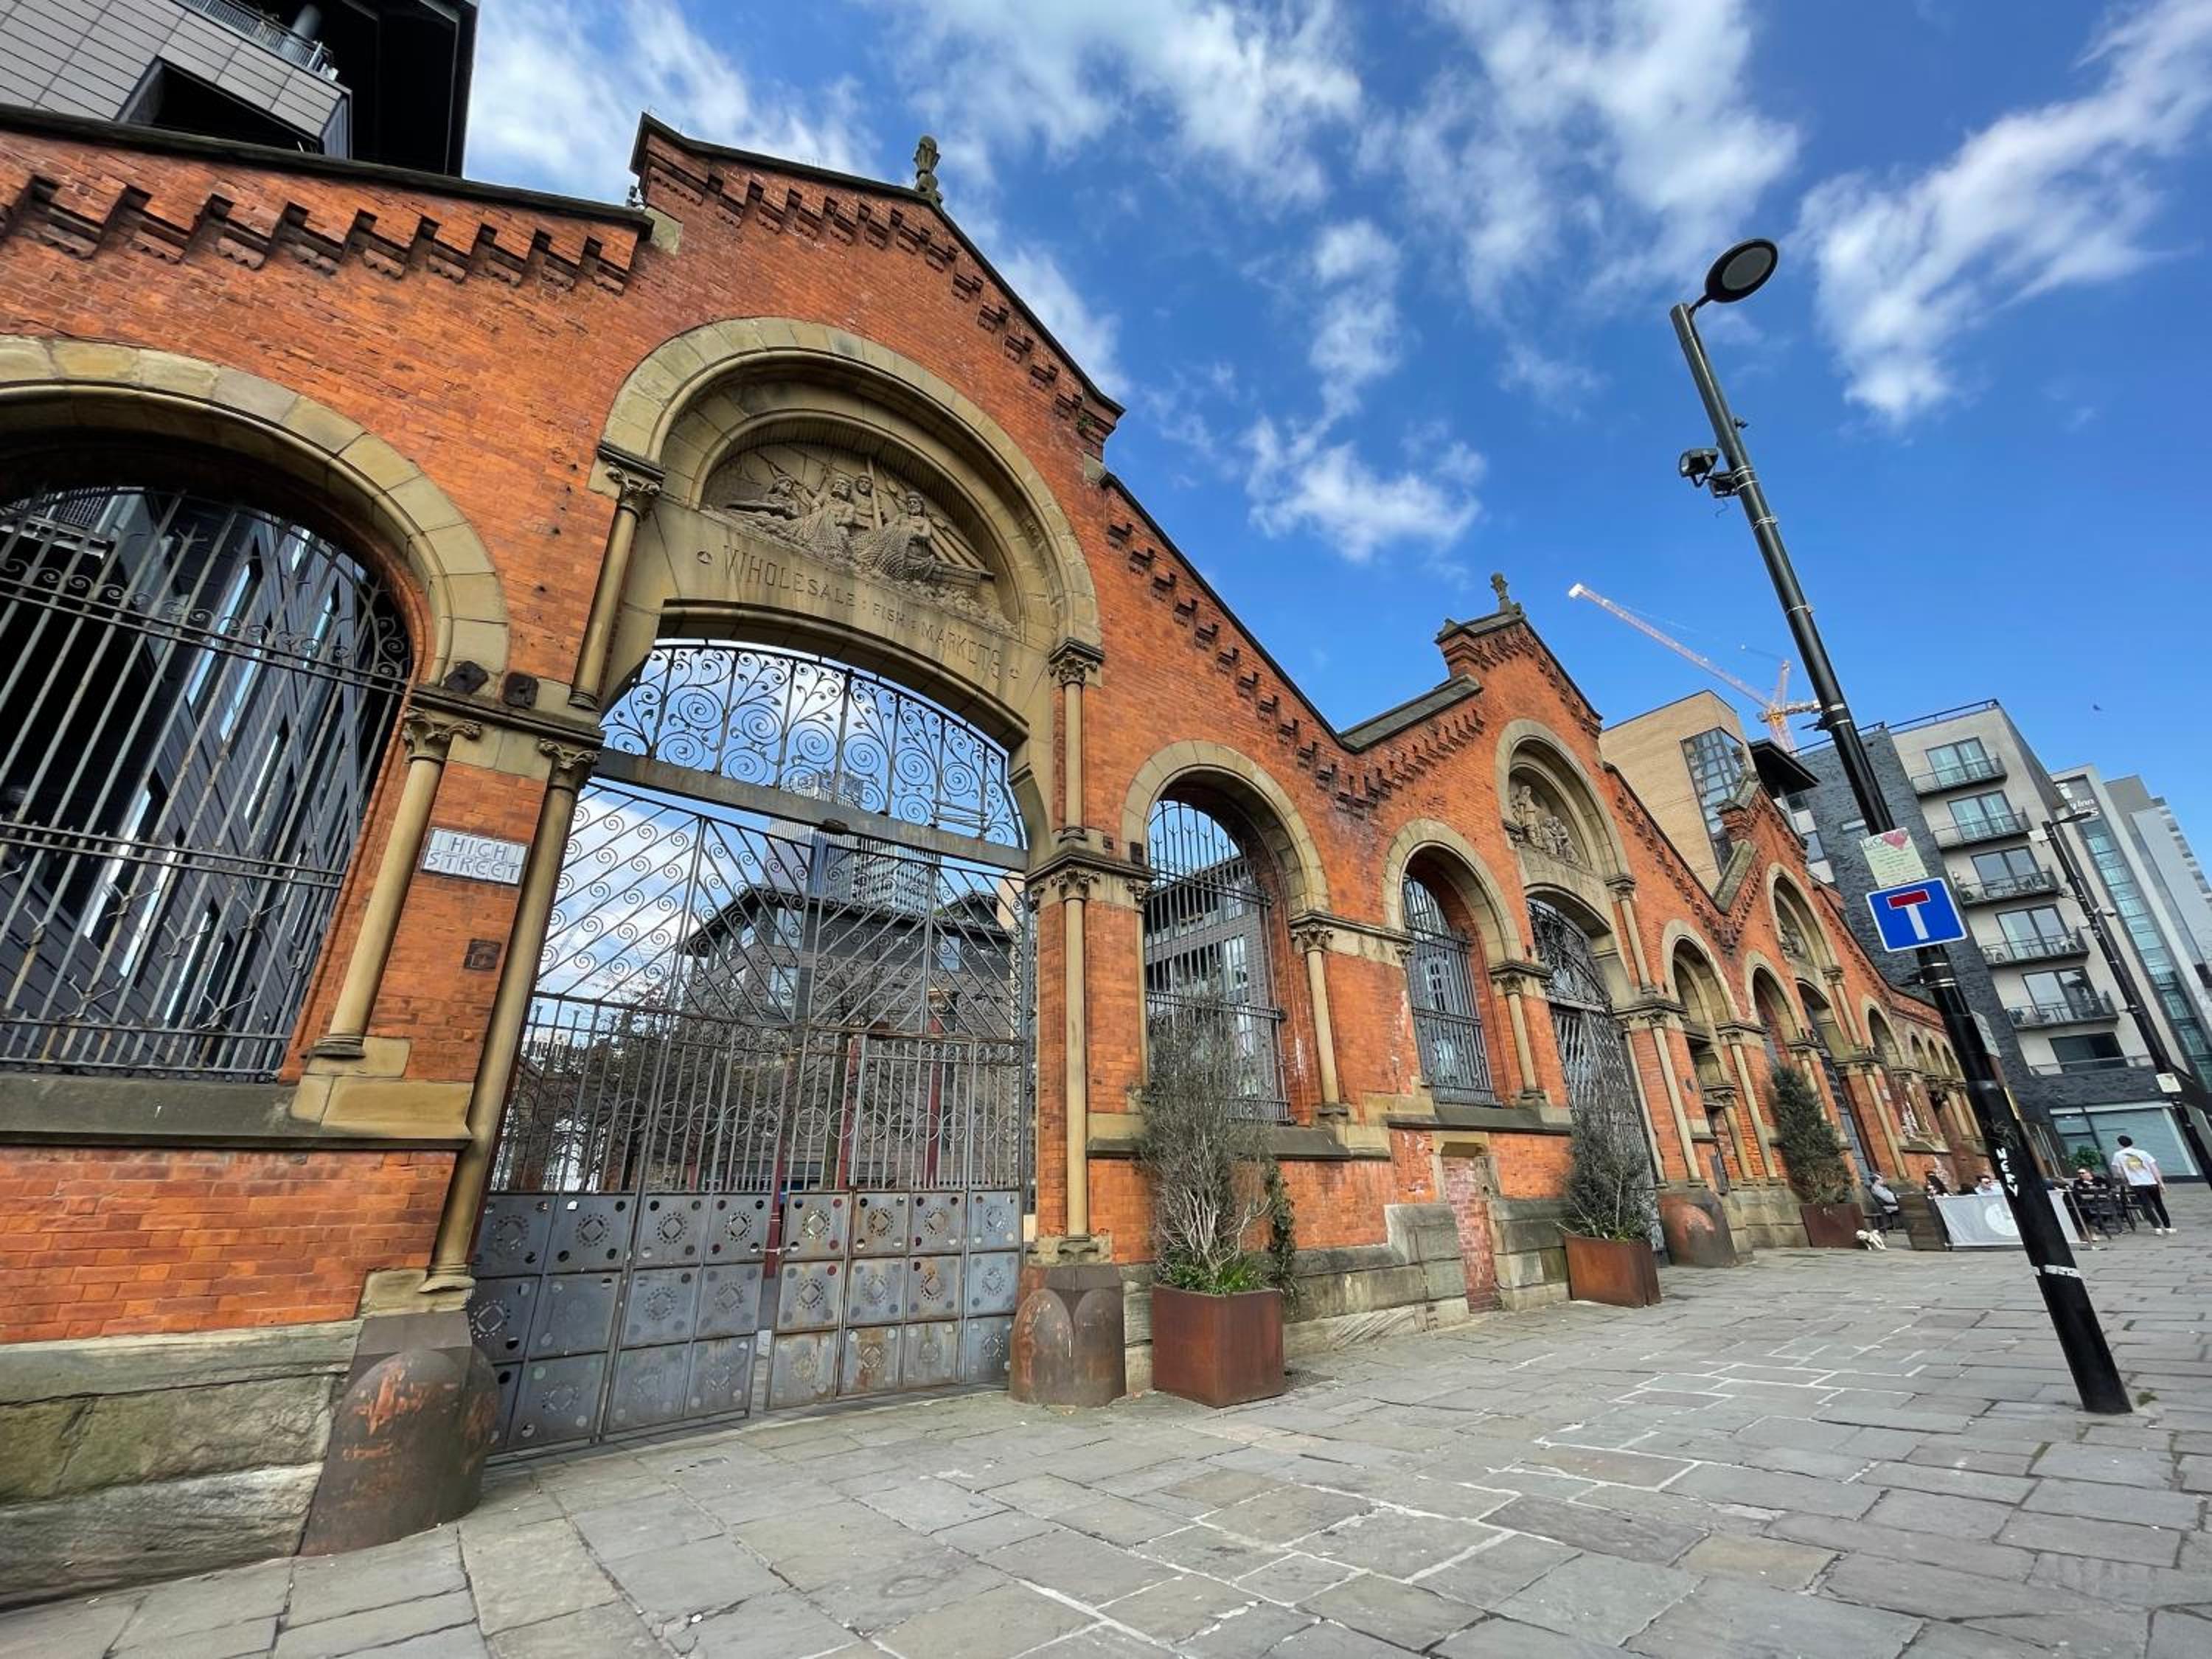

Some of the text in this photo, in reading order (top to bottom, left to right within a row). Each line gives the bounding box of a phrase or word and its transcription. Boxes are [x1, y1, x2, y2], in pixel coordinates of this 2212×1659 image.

[723, 545, 1001, 680] WHOLESALE FISH MARKETS
[450, 836, 508, 860] HIGH
[426, 852, 519, 880] STREET
